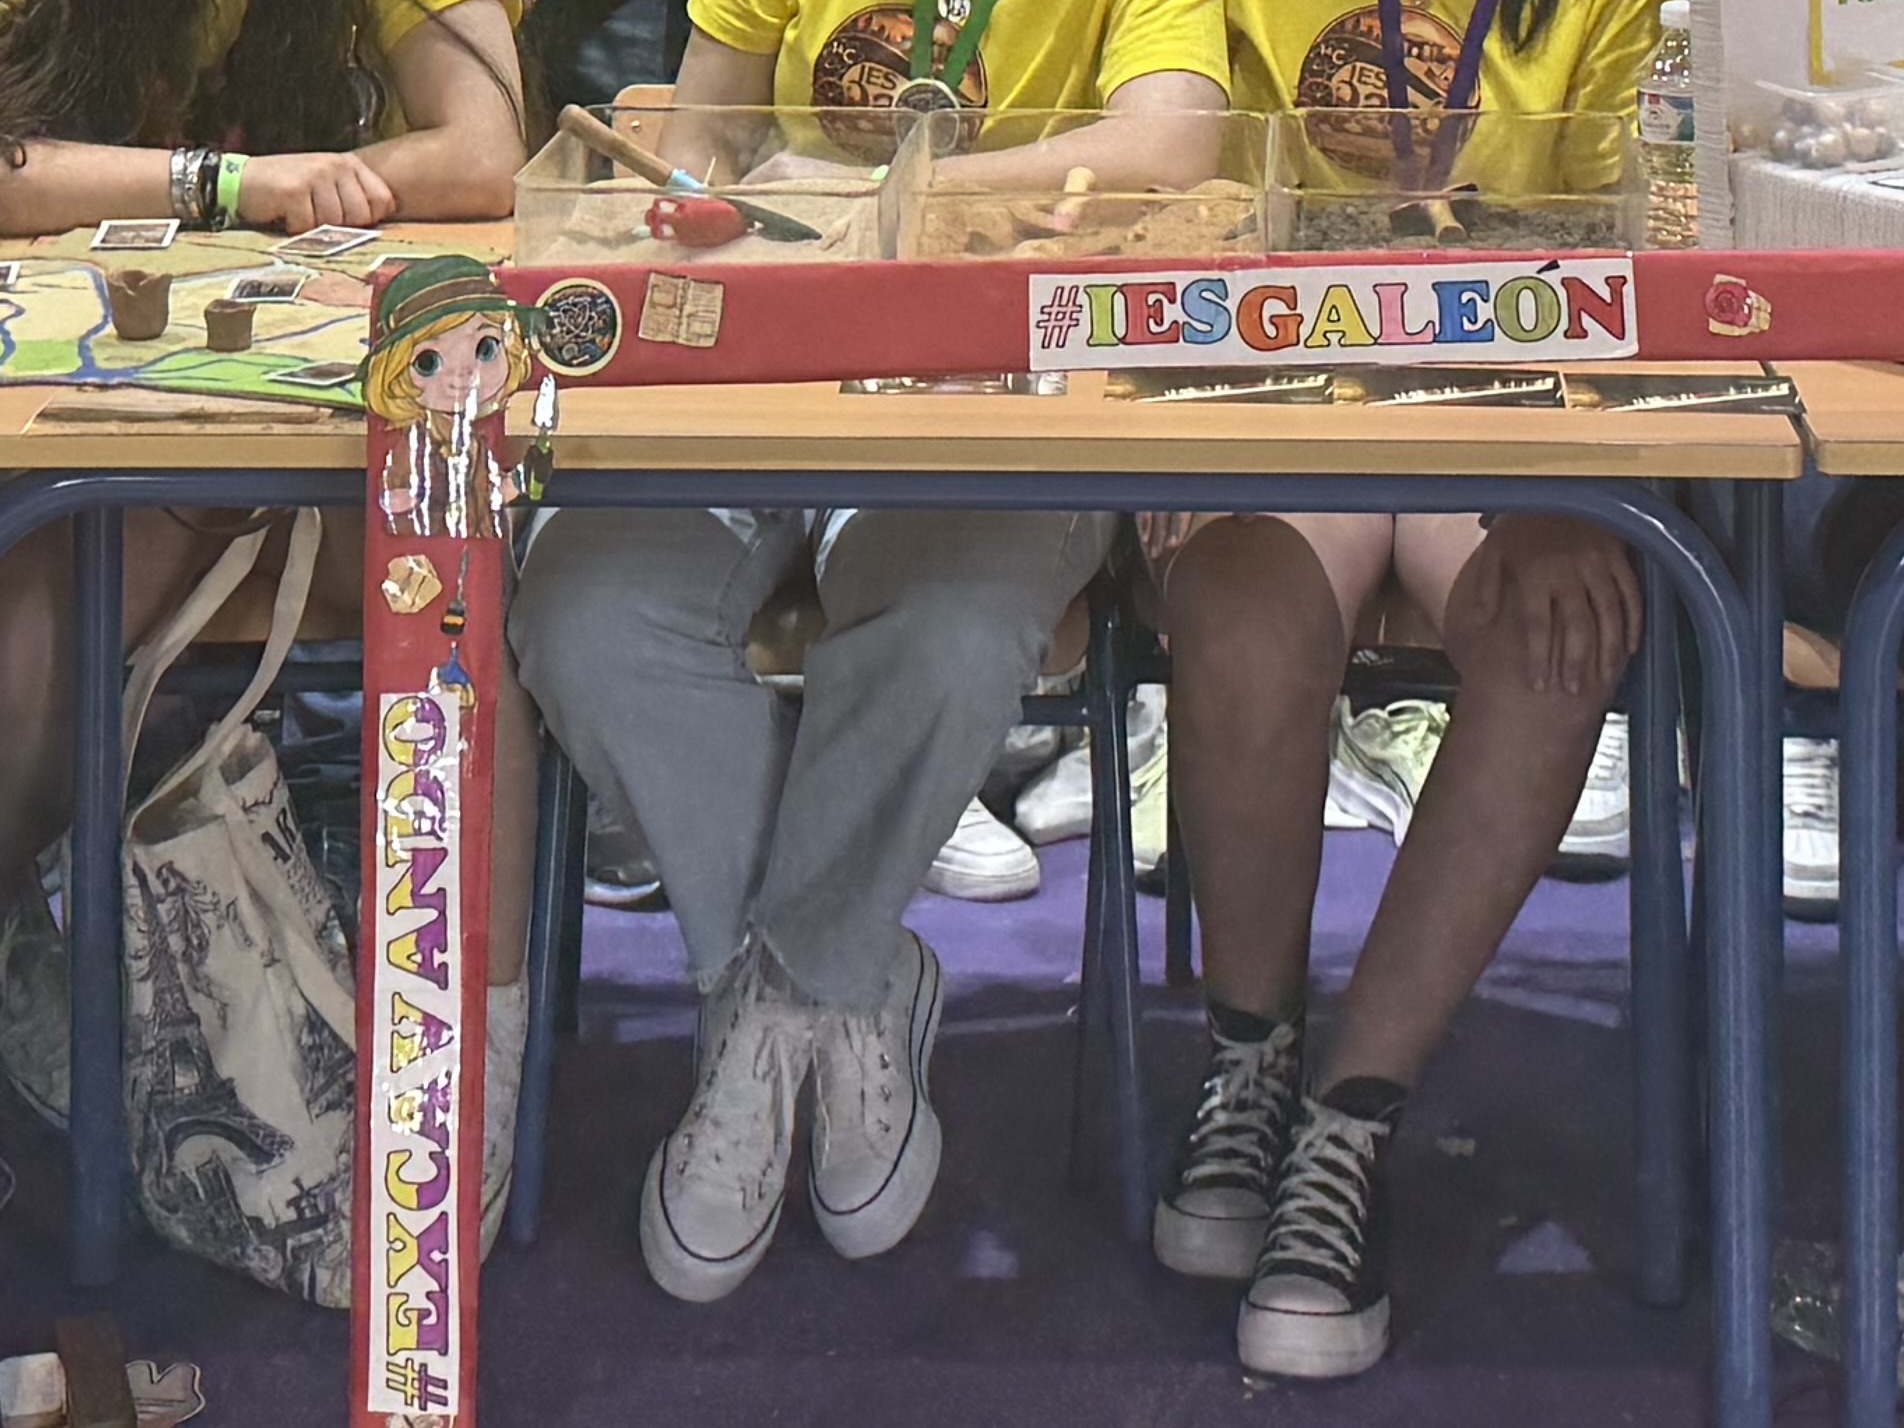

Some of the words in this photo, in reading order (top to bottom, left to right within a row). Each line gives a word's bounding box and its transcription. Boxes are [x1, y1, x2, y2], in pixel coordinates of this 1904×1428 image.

[857, 64, 897, 91] IES
[1036, 260, 1627, 352] #IESGALEÓN
[382, 694, 452, 1412] #EXCAVANDO
